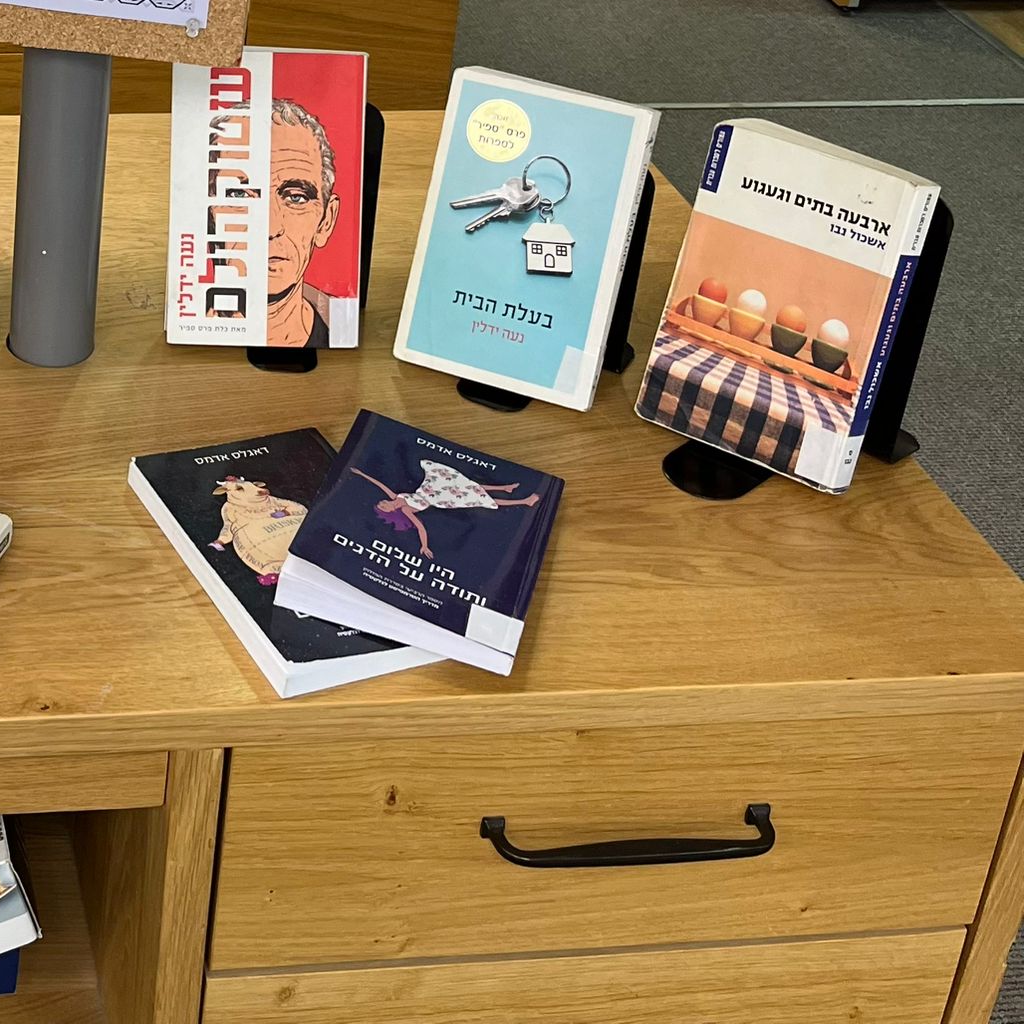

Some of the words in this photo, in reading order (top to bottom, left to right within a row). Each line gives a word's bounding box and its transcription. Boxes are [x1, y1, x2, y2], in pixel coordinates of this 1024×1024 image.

[479, 135, 514, 149] לספרות
[198, 67, 261, 318] שטוקהולם
[740, 176, 790, 203] וגעגוע
[794, 194, 834, 217] בתים
[830, 223, 846, 238] נבו
[838, 207, 891, 237] ארבעה
[180, 234, 194, 267] נעה
[850, 230, 886, 250] אשכול
[898, 261, 912, 295] ארבעה
[178, 273, 196, 317] ידלין
[452, 289, 497, 314] הבית
[501, 300, 553, 329] בעלת
[890, 297, 902, 323] בתים
[471, 319, 500, 337] ידלין
[501, 326, 525, 344] נעה
[880, 324, 893, 357] וגעגוע
[869, 361, 882, 395] אשכול
[863, 394, 874, 410] נבו
[231, 446, 270, 460] דאגלס
[416, 436, 453, 456] אדמס
[194, 453, 230, 466] אדמס
[456, 450, 497, 472] דאגלס
[334, 531, 391, 568] הדגים
[372, 539, 422, 568] שלום
[399, 563, 424, 582] על
[429, 563, 455, 581] היו
[431, 578, 486, 606] ותודה
